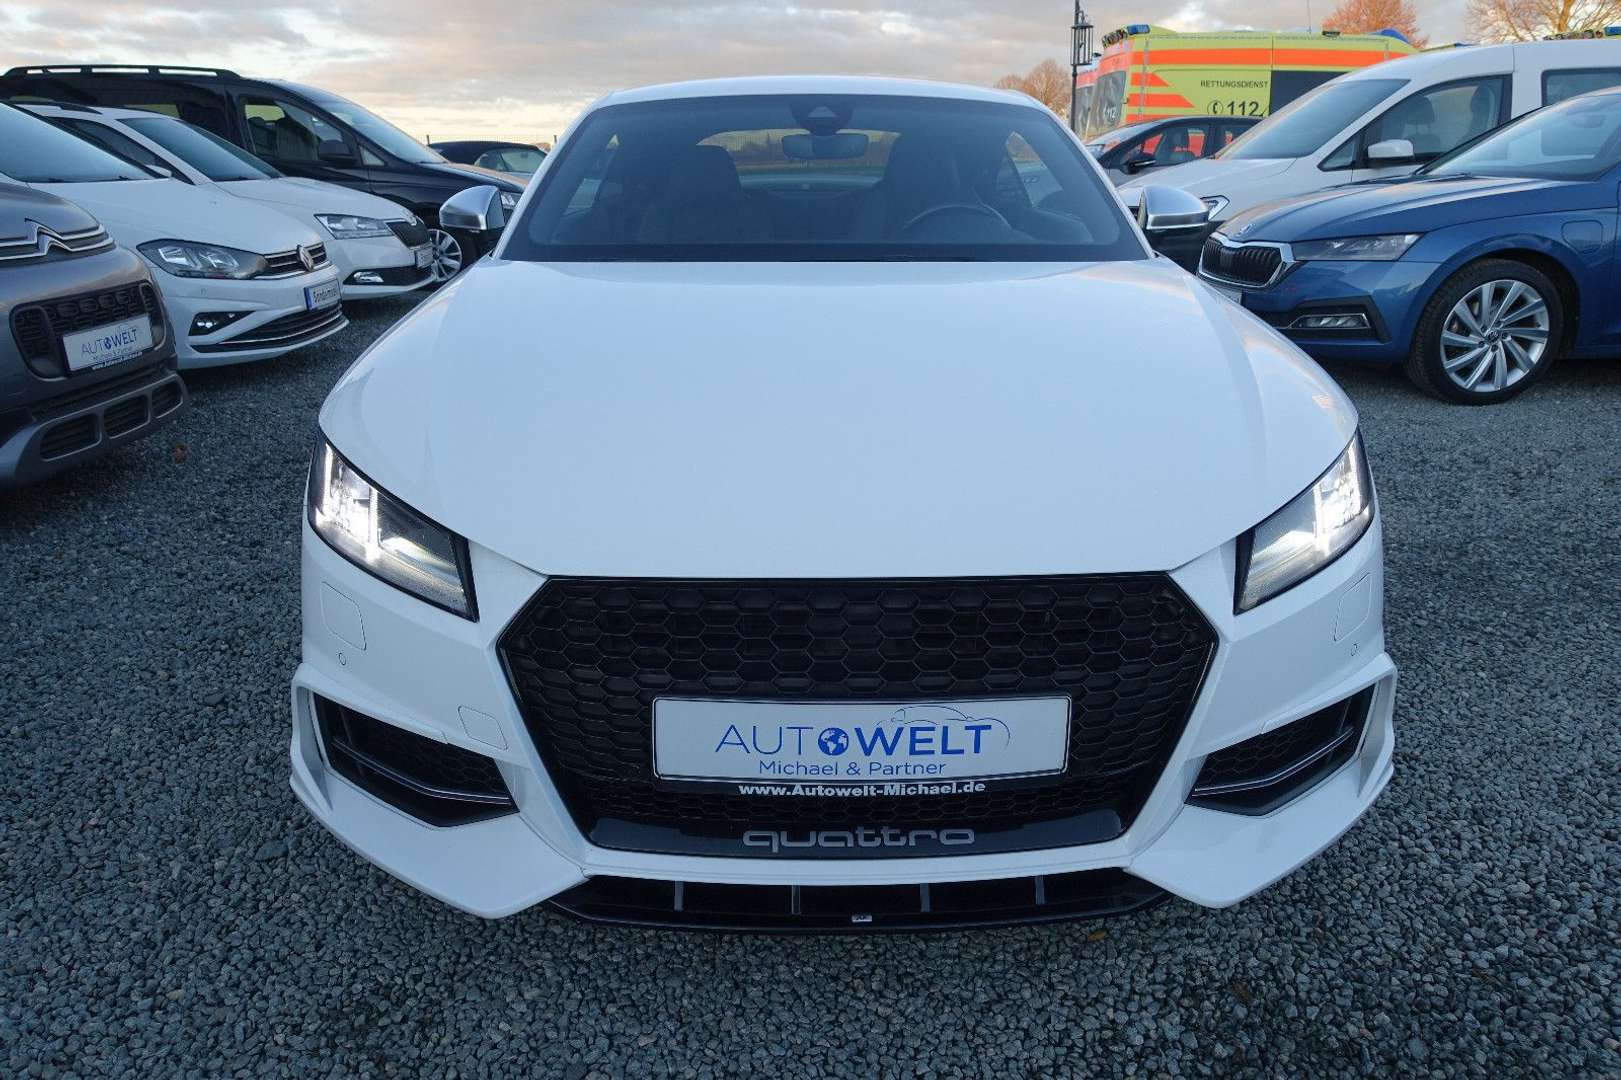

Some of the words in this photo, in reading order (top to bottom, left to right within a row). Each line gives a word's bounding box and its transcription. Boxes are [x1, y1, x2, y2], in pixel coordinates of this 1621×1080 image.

[1200, 79, 1269, 89] RETTUNGSDIENST
[1226, 100, 1264, 117] 112
[714, 723, 993, 757] AUTOWELT
[759, 759, 839, 776] Michael
[846, 761, 861, 776] &
[868, 761, 947, 776] Partner
[738, 781, 987, 798] www.Autowelt-Michael.de
[742, 825, 976, 854] quattro
